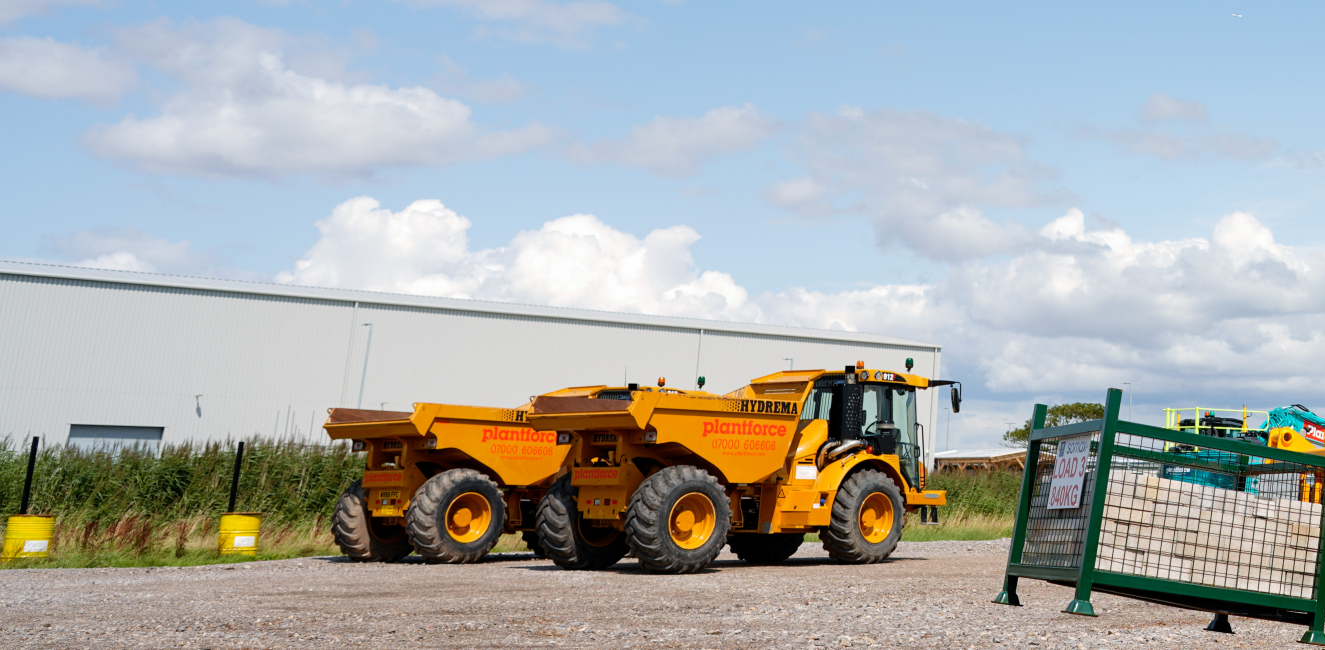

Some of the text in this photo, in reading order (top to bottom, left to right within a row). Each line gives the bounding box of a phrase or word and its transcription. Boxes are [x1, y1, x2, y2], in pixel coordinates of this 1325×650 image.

[740, 399, 798, 415] HYDREMA
[481, 426, 557, 443] plantforc
[702, 418, 787, 437] plantforce
[490, 443, 553, 456] 07000 606606
[711, 438, 776, 451] 07000 606606
[573, 468, 619, 481] plantforce
[1053, 456, 1086, 479] LOAD 3
[364, 472, 402, 484] plantforce
[1050, 484, 1079, 507] 840KG
